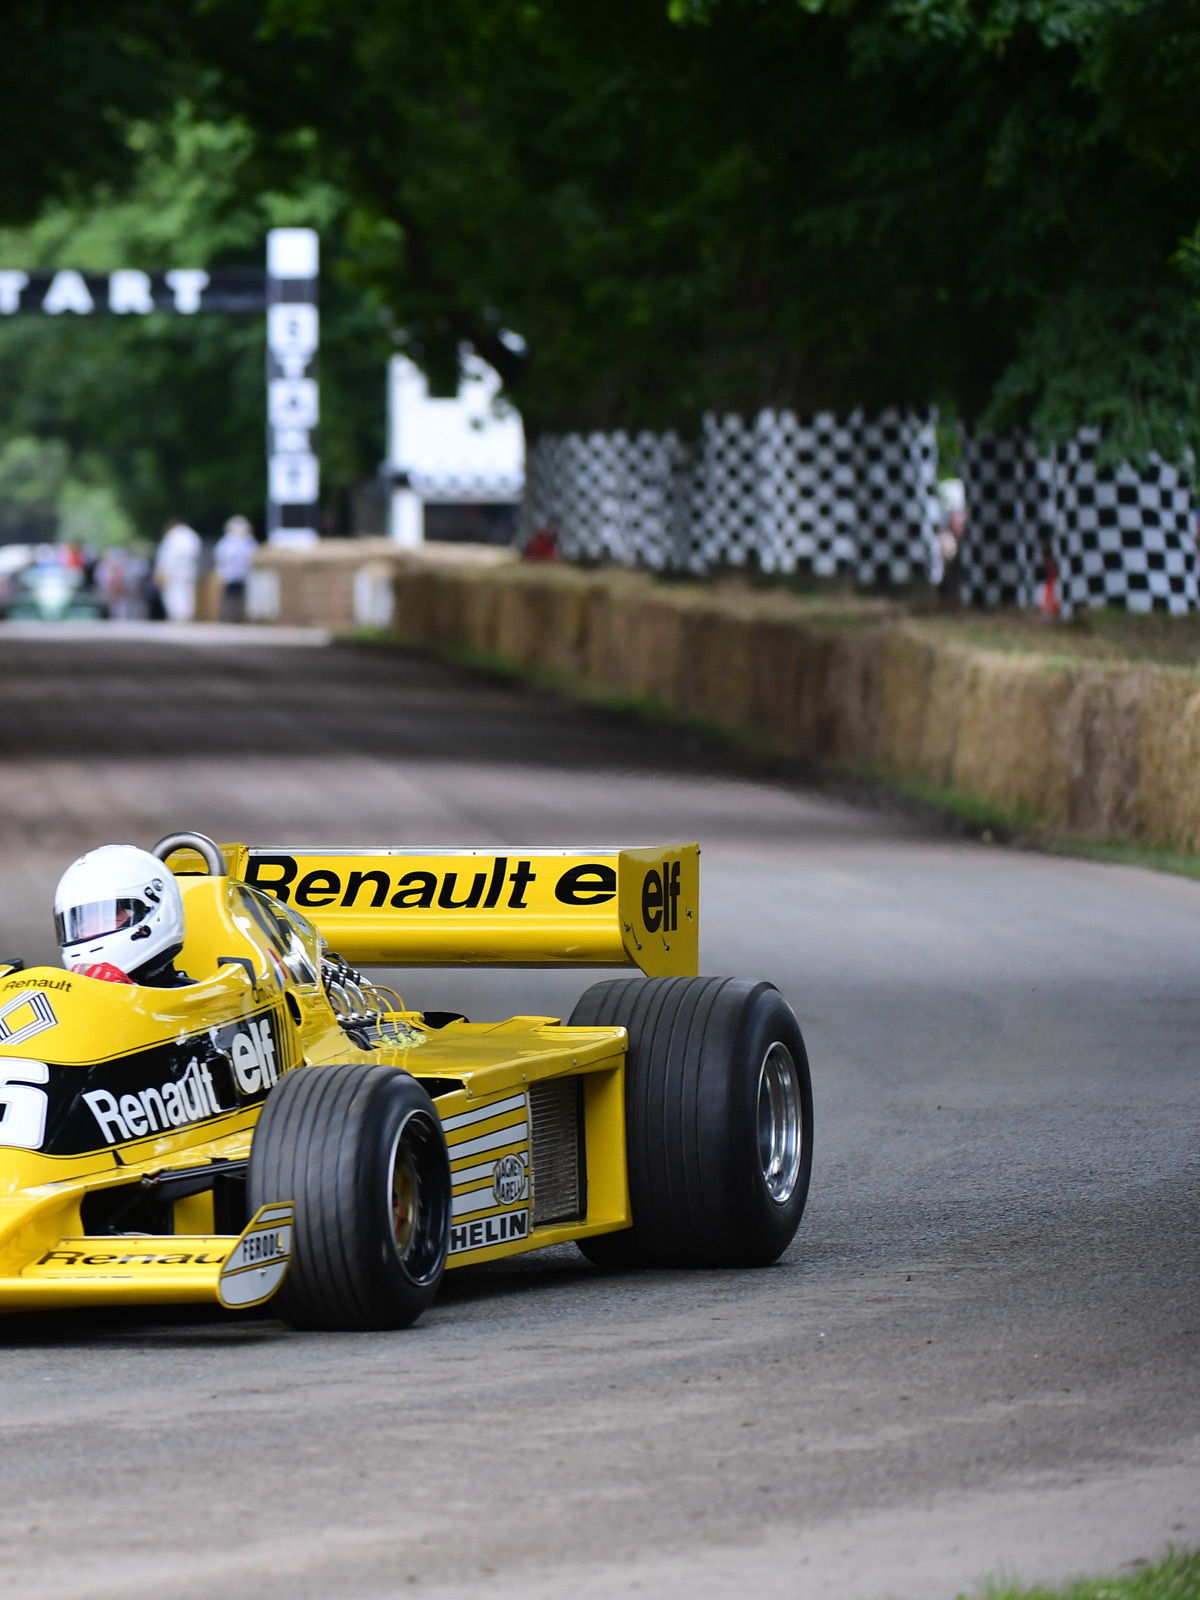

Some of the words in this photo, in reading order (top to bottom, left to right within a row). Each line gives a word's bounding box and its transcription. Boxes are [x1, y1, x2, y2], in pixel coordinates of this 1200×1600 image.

[244, 856, 536, 909] Renault
[641, 860, 671, 934] elf
[3, 979, 72, 992] Renault
[231, 1018, 278, 1094] elf
[81, 1055, 222, 1144] Renault
[450, 1212, 527, 1251] HELIN
[35, 1251, 226, 1266] Renau
